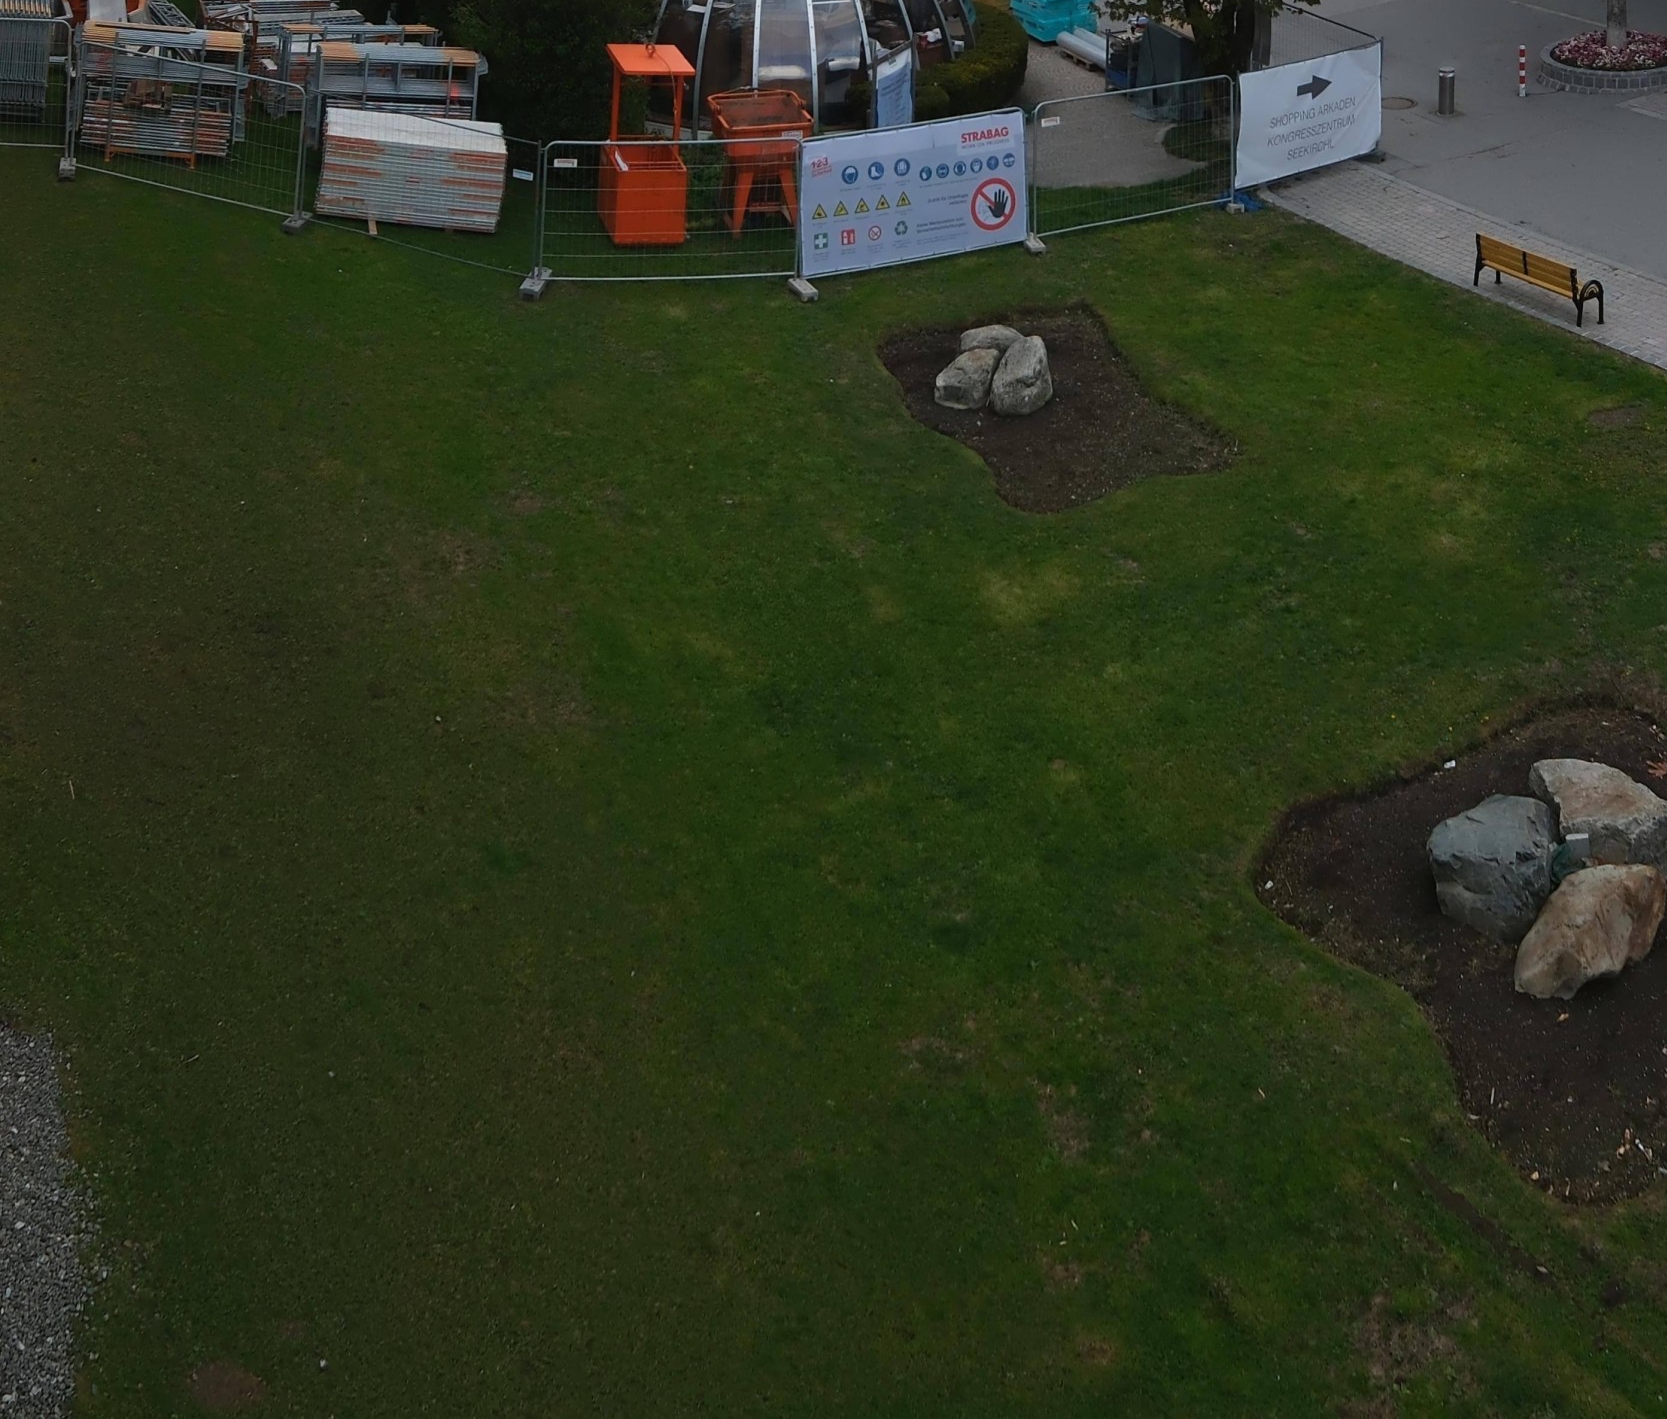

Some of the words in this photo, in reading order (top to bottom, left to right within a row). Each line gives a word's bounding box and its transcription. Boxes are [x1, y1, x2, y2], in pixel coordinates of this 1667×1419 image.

[1269, 108, 1316, 129] SHOPPING
[1317, 97, 1356, 116] ARKADEN
[961, 126, 1009, 143] STRABAG
[1267, 114, 1356, 147] KONGRESSZENTRUM
[1287, 138, 1335, 161] SEEKIRCHL
